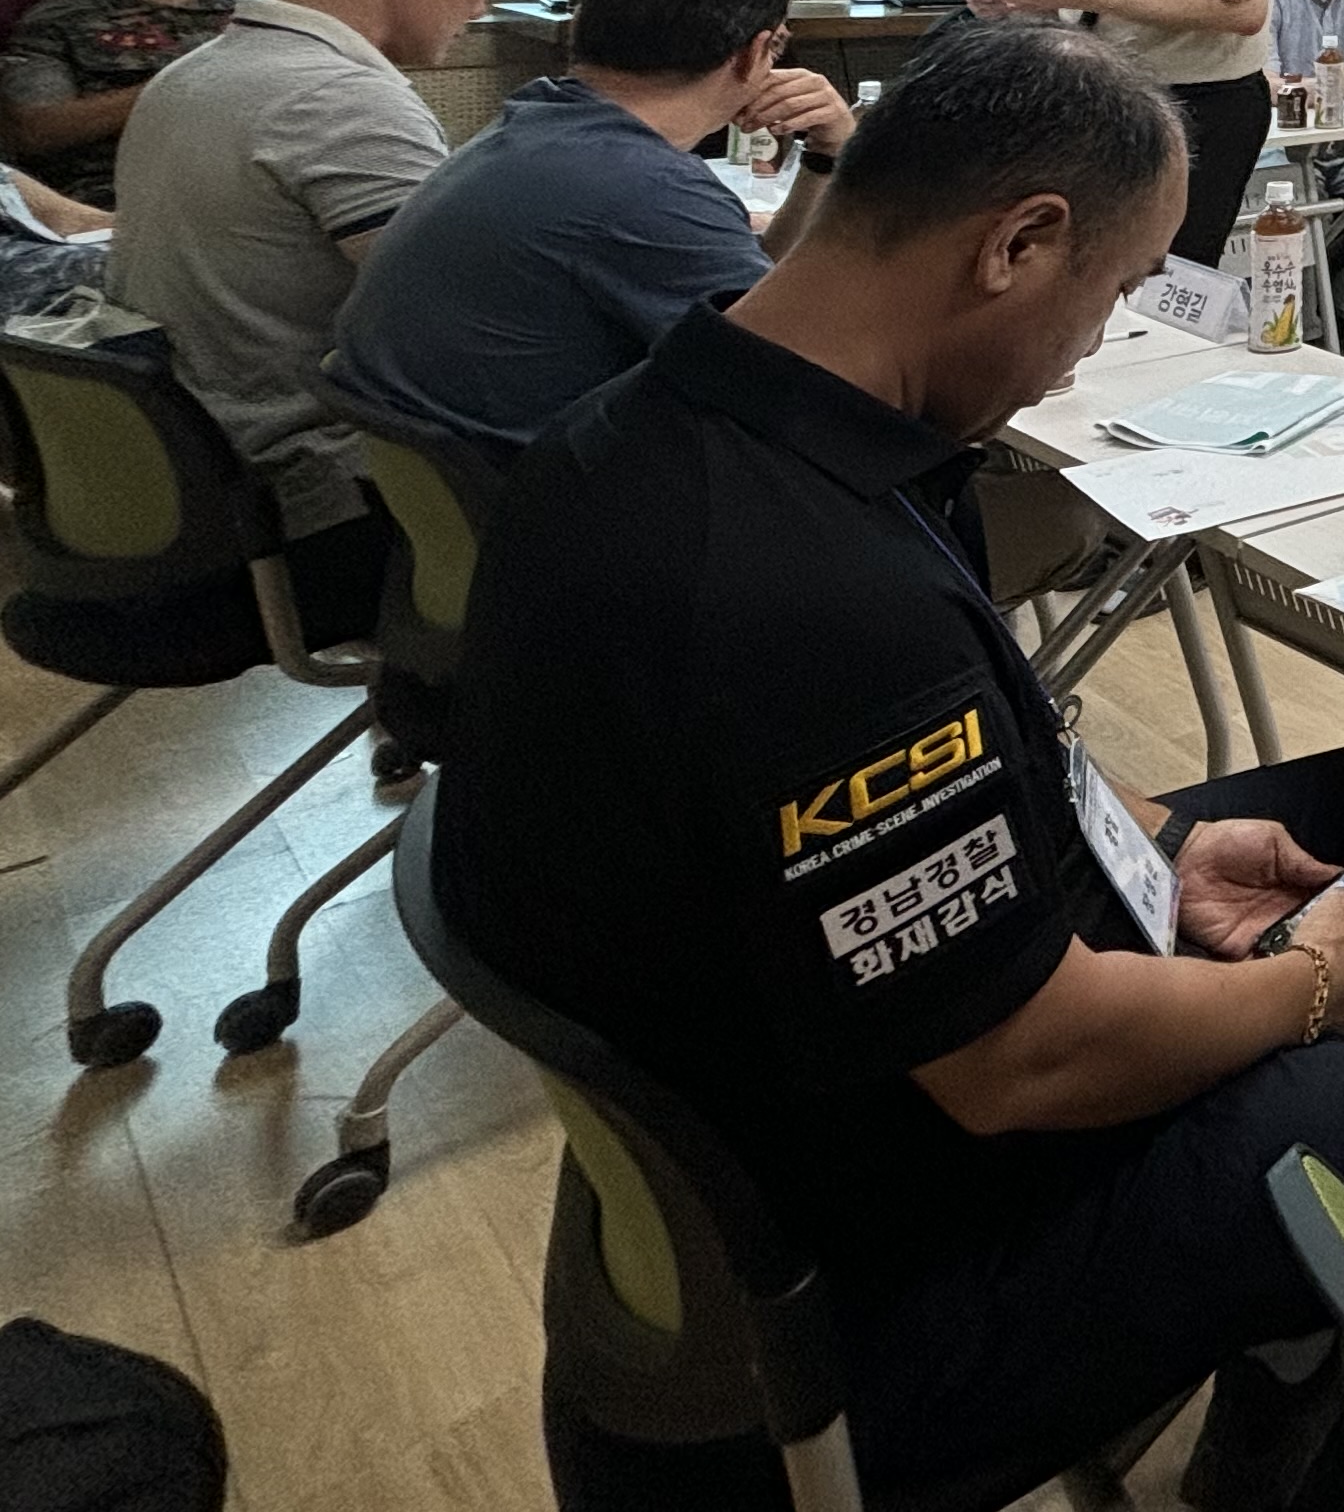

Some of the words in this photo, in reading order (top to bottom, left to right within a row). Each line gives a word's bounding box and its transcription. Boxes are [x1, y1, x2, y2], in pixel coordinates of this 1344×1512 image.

[1261, 260, 1296, 280] 옥수수
[779, 708, 985, 858] KCSI
[783, 850, 832, 883] KOREA
[832, 827, 876, 861] CRIME
[875, 801, 922, 838] SCENE
[920, 755, 1003, 813] INVESTIGATION
[839, 826, 1002, 938] 경남경찰
[849, 865, 1020, 987] 화재감식
